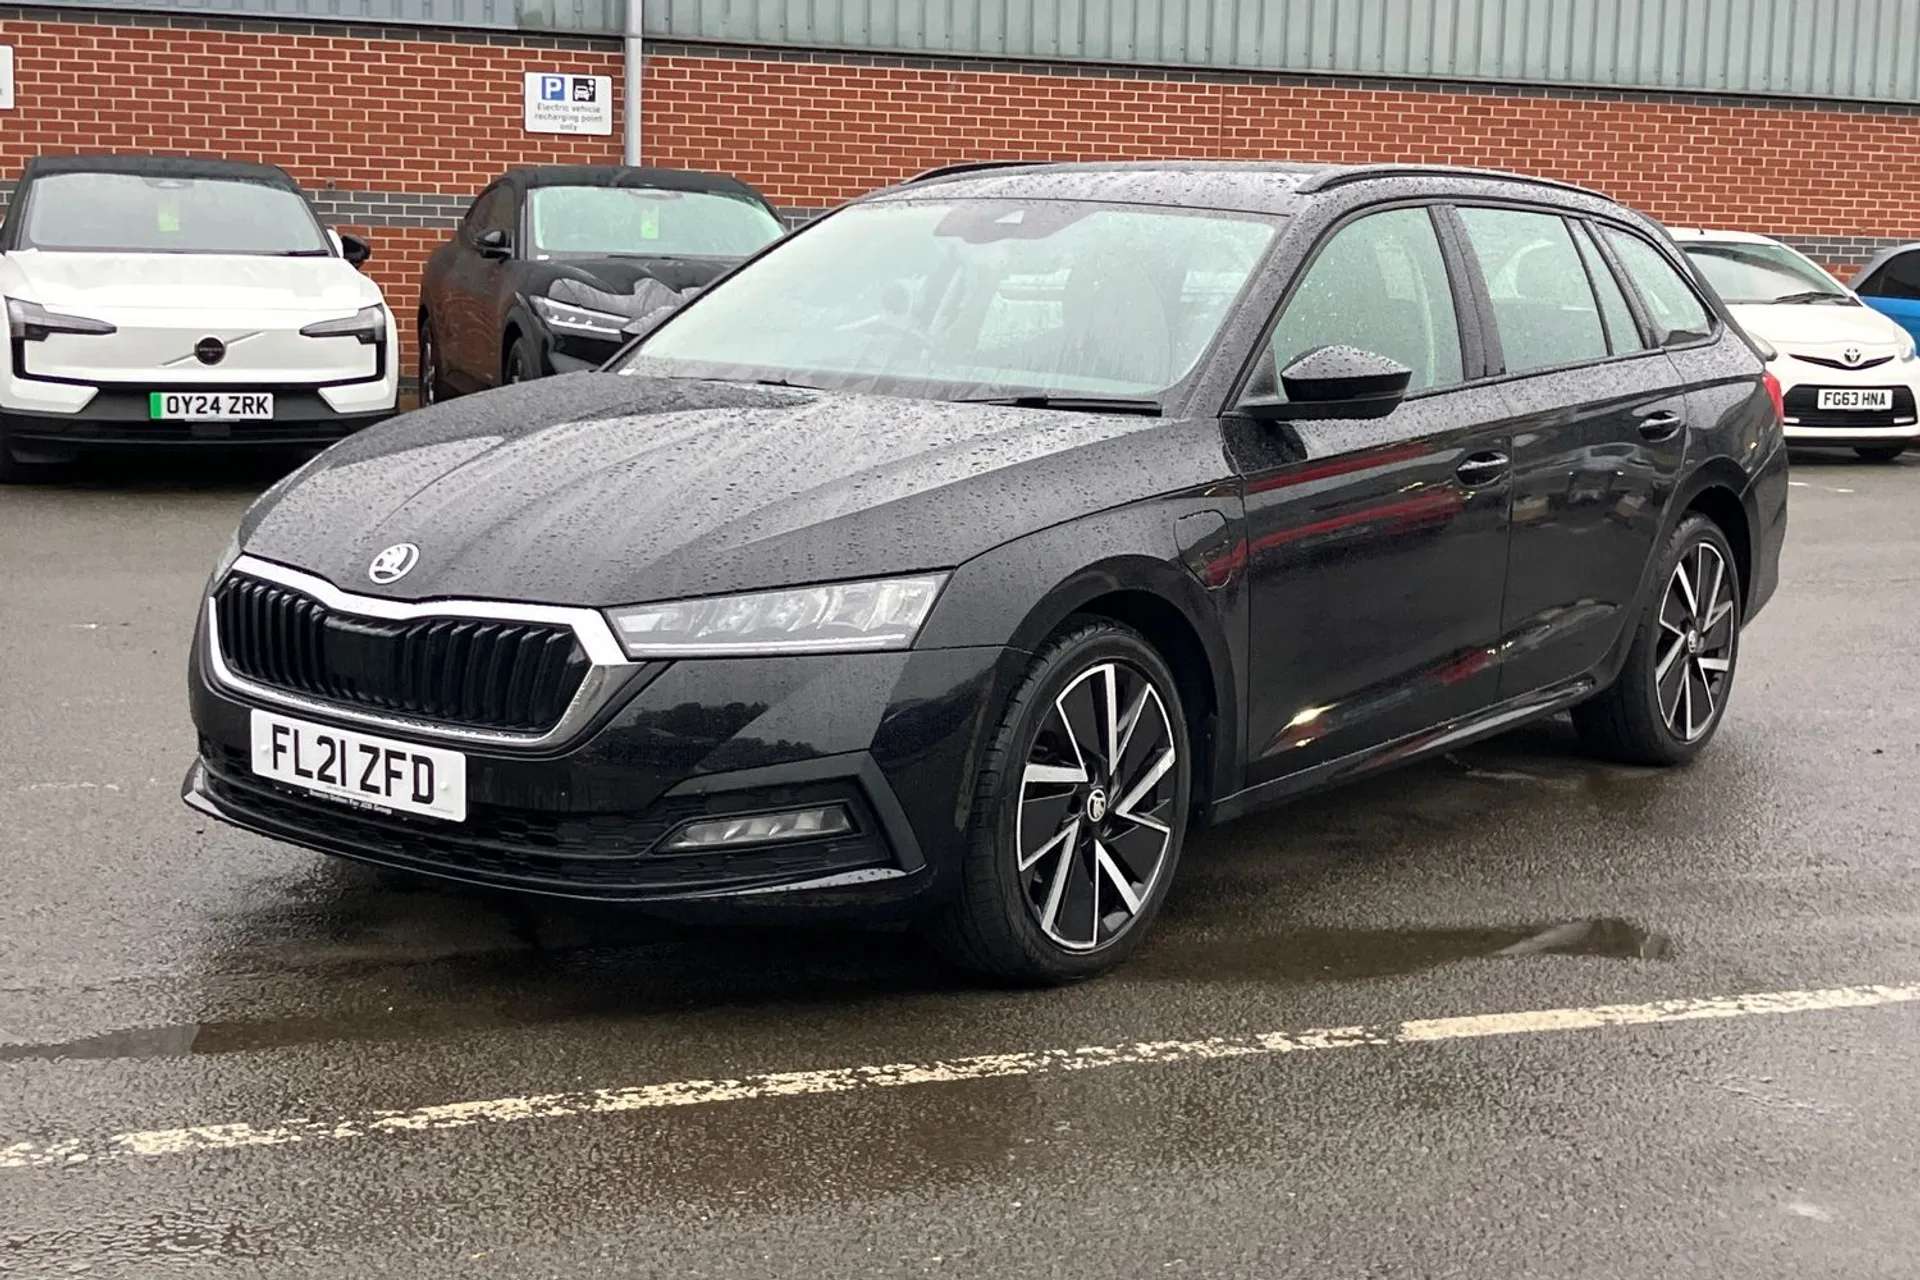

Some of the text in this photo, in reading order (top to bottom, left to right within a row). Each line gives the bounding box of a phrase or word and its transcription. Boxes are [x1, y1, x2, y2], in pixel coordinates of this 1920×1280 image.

[545, 78, 562, 99] P
[537, 103, 600, 113] Electric vehicle
[534, 113, 602, 123] recharging point
[560, 123, 577, 131] only
[167, 396, 268, 414] OY24 ZRK
[1824, 391, 1886, 406] FG63 HNA
[272, 723, 347, 787] FL21
[359, 743, 434, 805] ZFD
